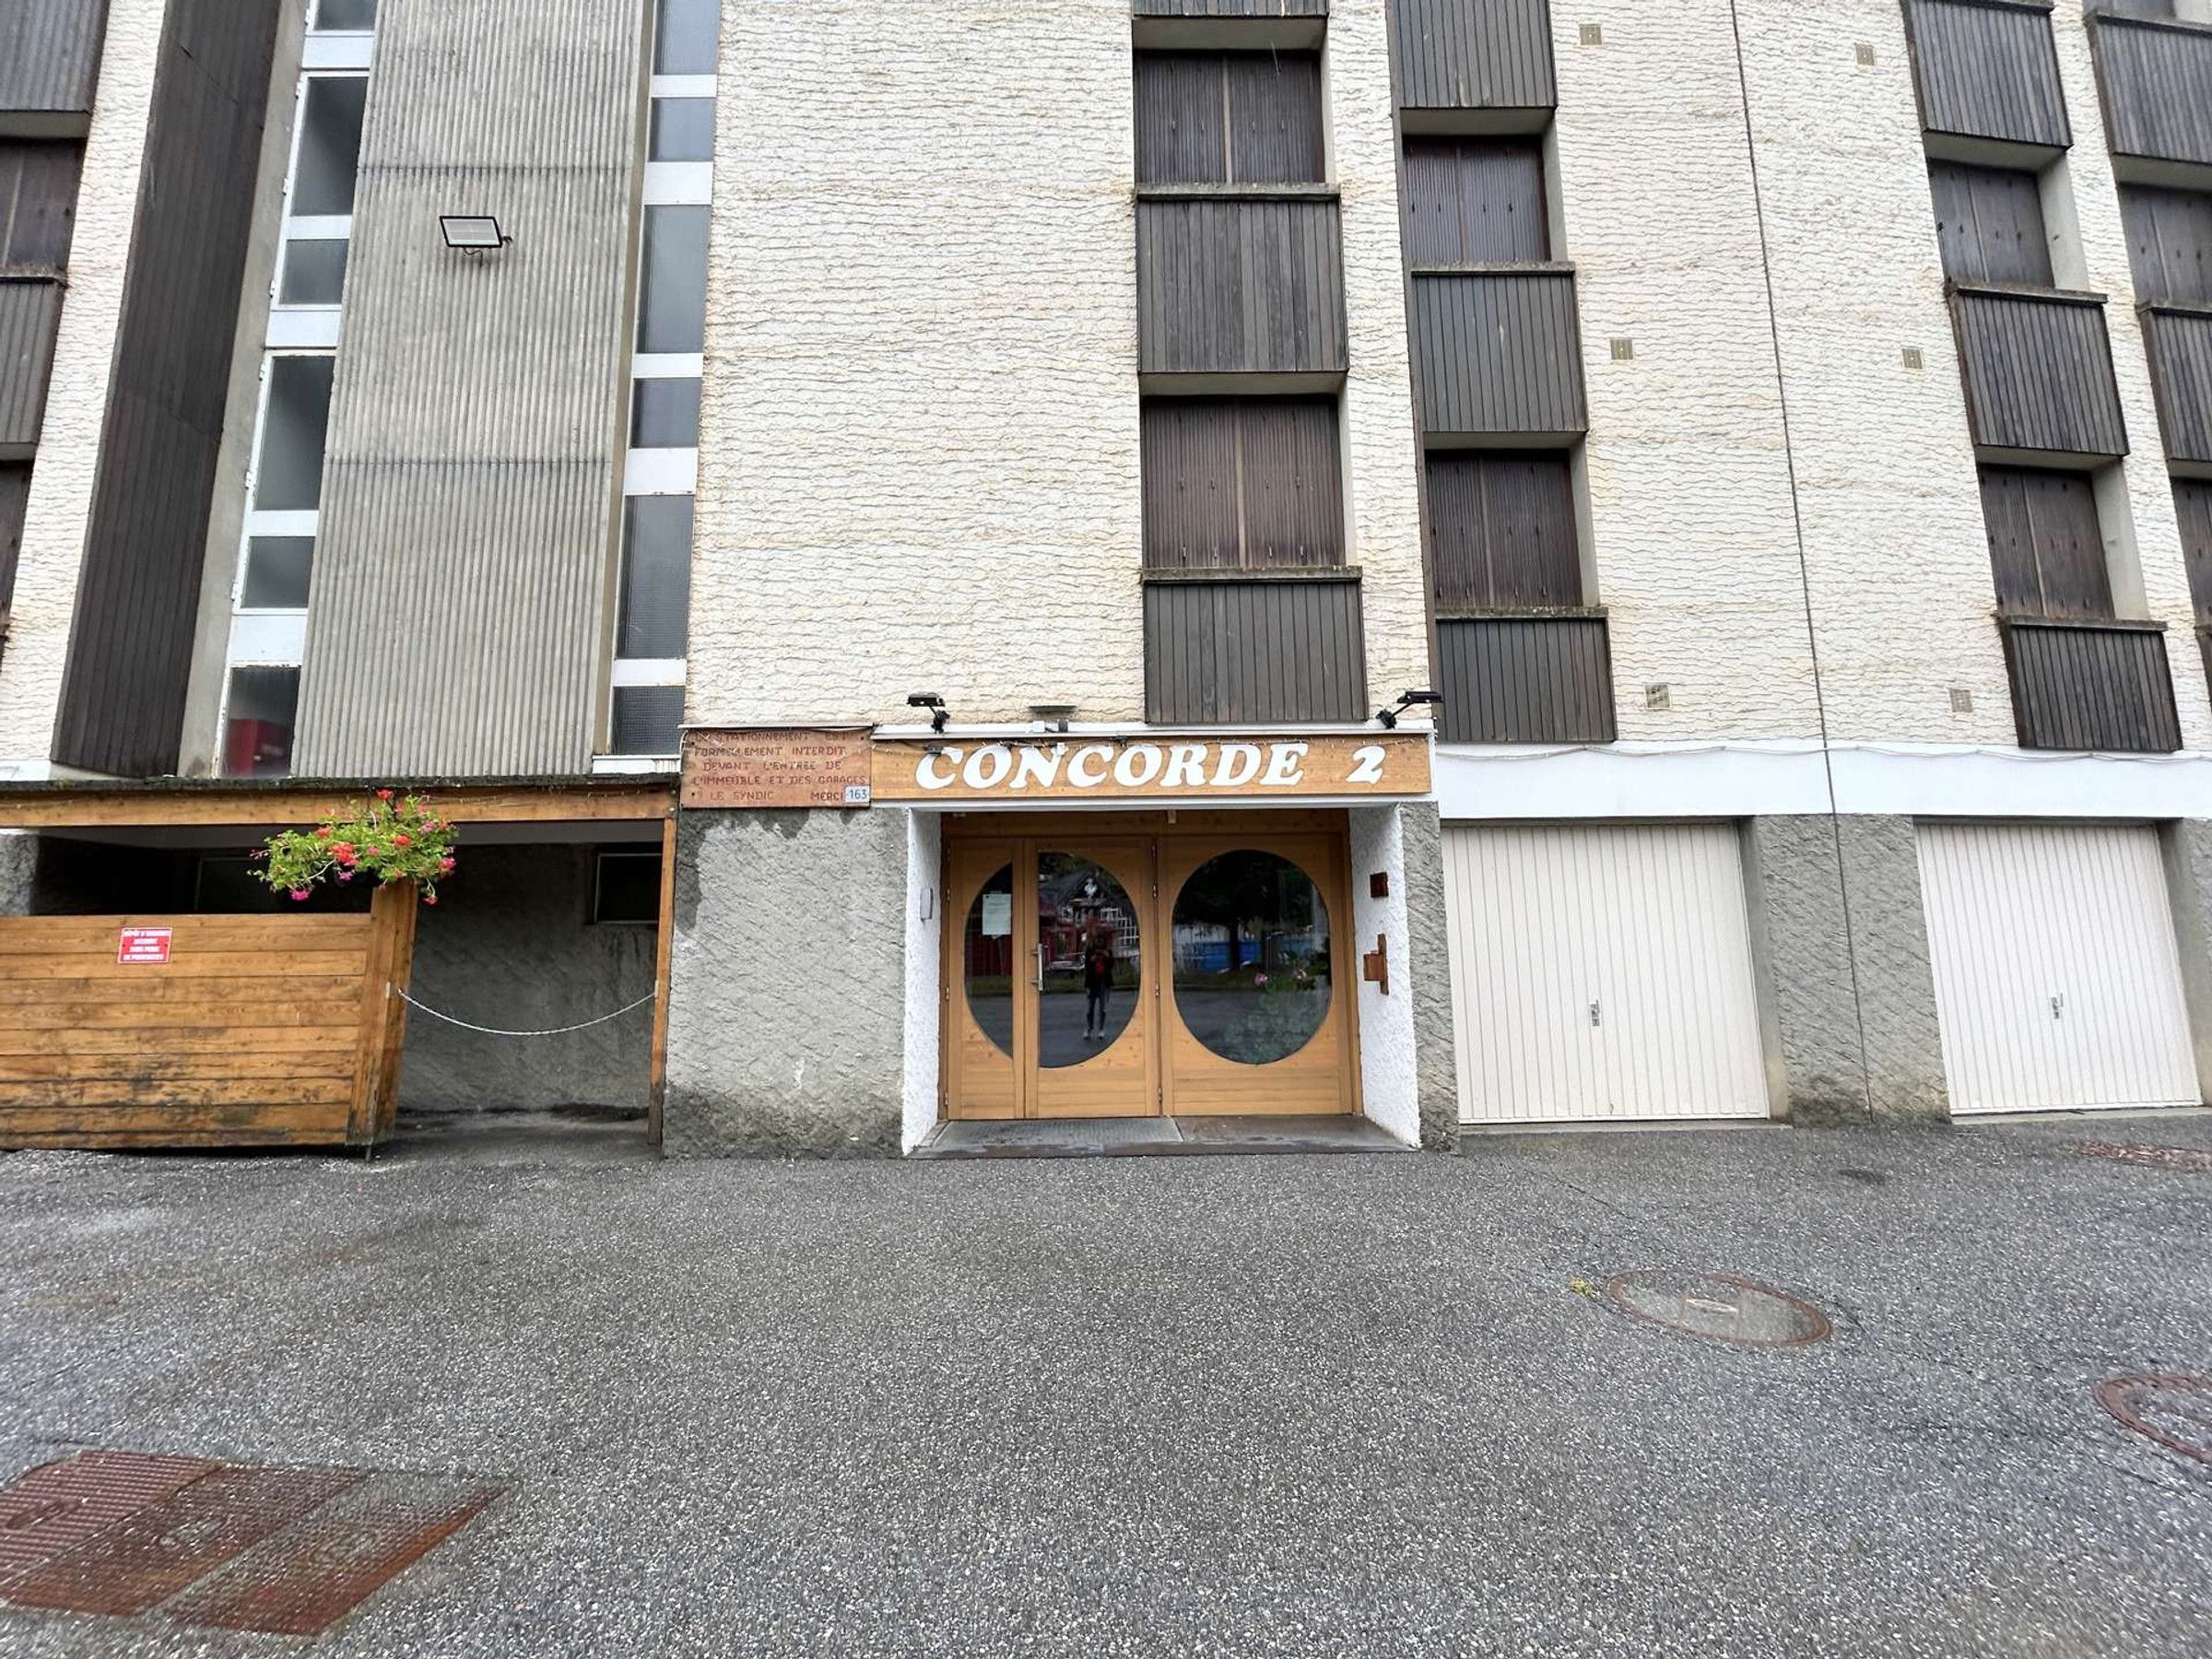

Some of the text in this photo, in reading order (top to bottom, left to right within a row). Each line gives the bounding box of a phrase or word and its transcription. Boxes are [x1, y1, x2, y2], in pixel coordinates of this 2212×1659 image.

[716, 732, 810, 741] STATIONNEMENT
[825, 732, 848, 741] EST
[793, 746, 846, 756] INTERDIT
[703, 761, 750, 771] DEVANT
[826, 760, 841, 771] DE
[914, 742, 1386, 790] CONCORDE 2
[692, 775, 865, 785] L'IMMEUBLE ET DES GARAGES
[711, 791, 843, 801] LE SYNDIC MERCI
[849, 789, 867, 799] 163
